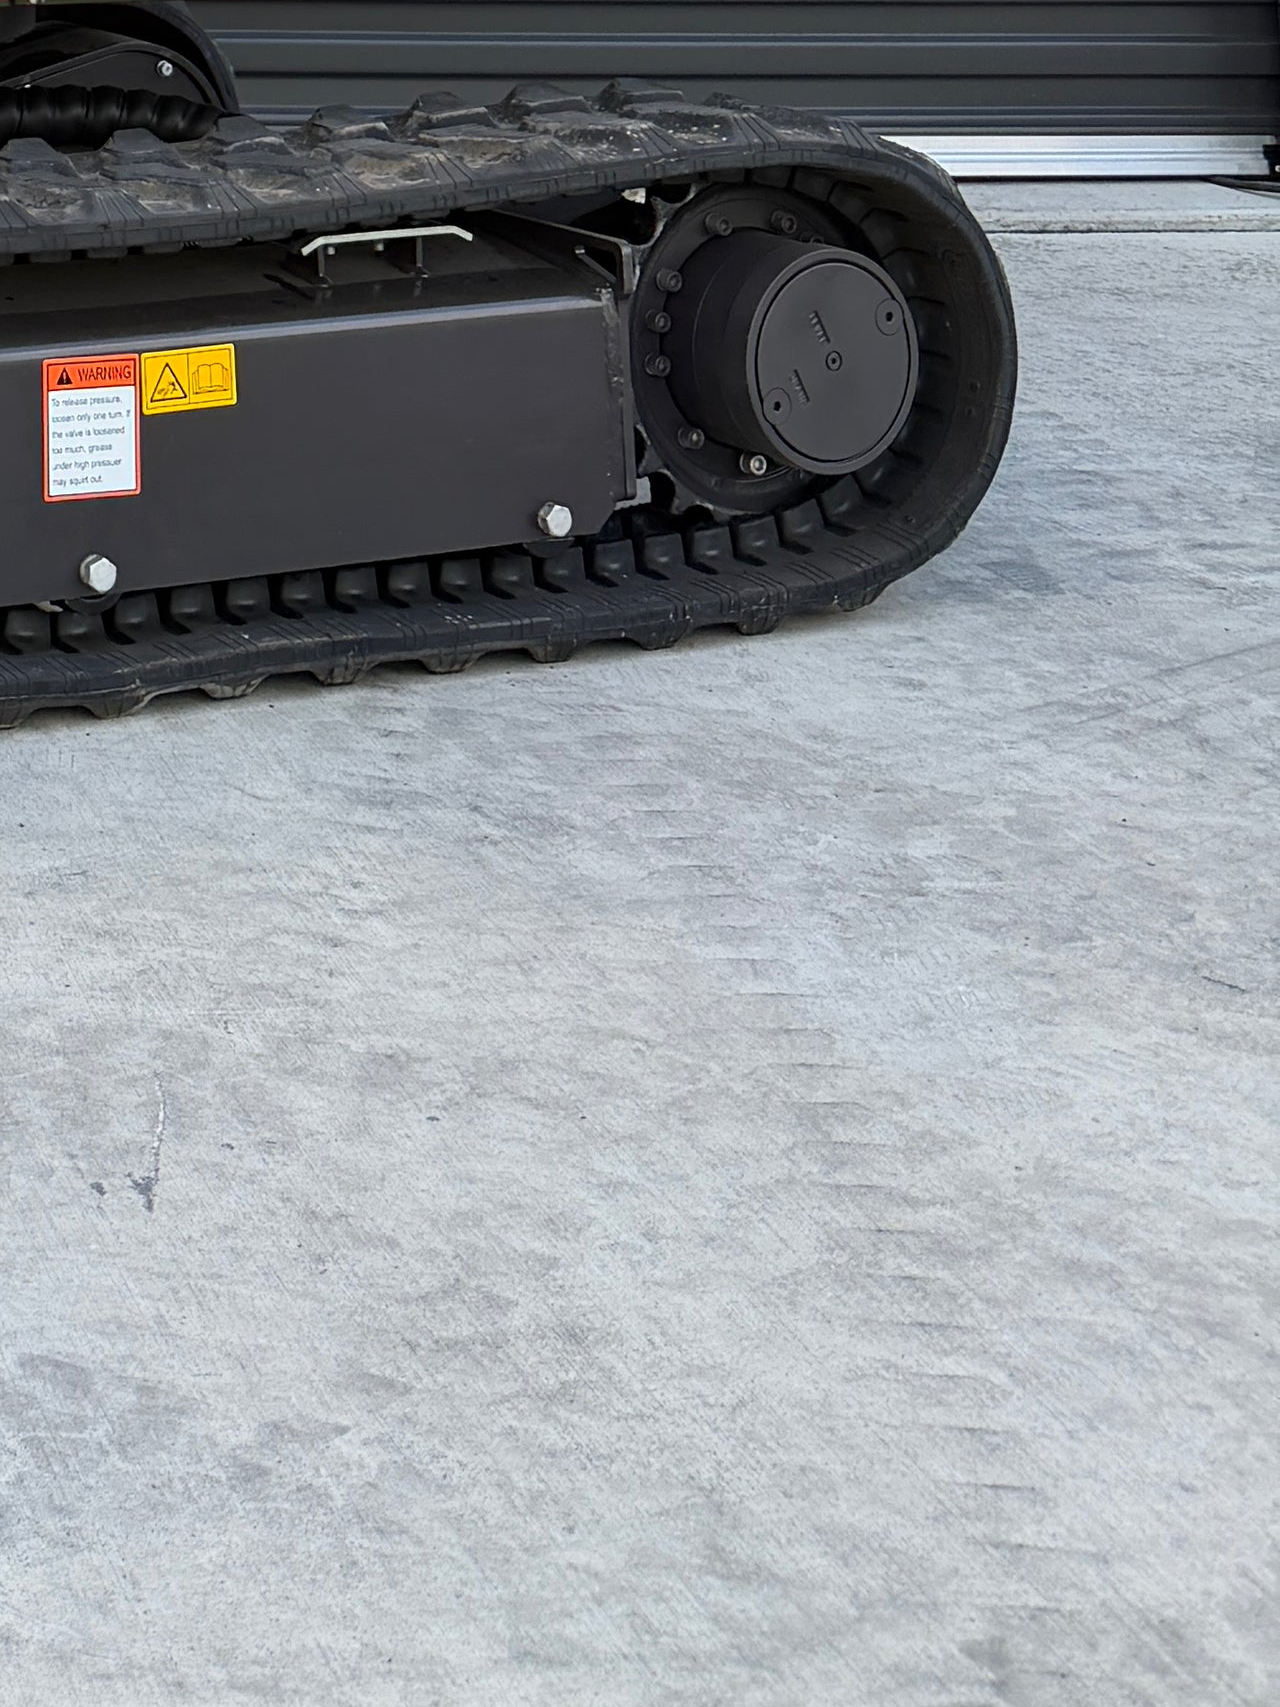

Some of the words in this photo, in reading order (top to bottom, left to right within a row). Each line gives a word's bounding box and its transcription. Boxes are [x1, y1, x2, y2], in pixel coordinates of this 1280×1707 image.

[78, 365, 132, 382] WARNING
[62, 397, 88, 406] release
[77, 413, 91, 423] only
[93, 412, 107, 421] one
[65, 428, 83, 438] valve
[85, 428, 92, 437] is
[93, 426, 125, 437] loosened
[88, 444, 113, 454] grease
[74, 460, 89, 471] high
